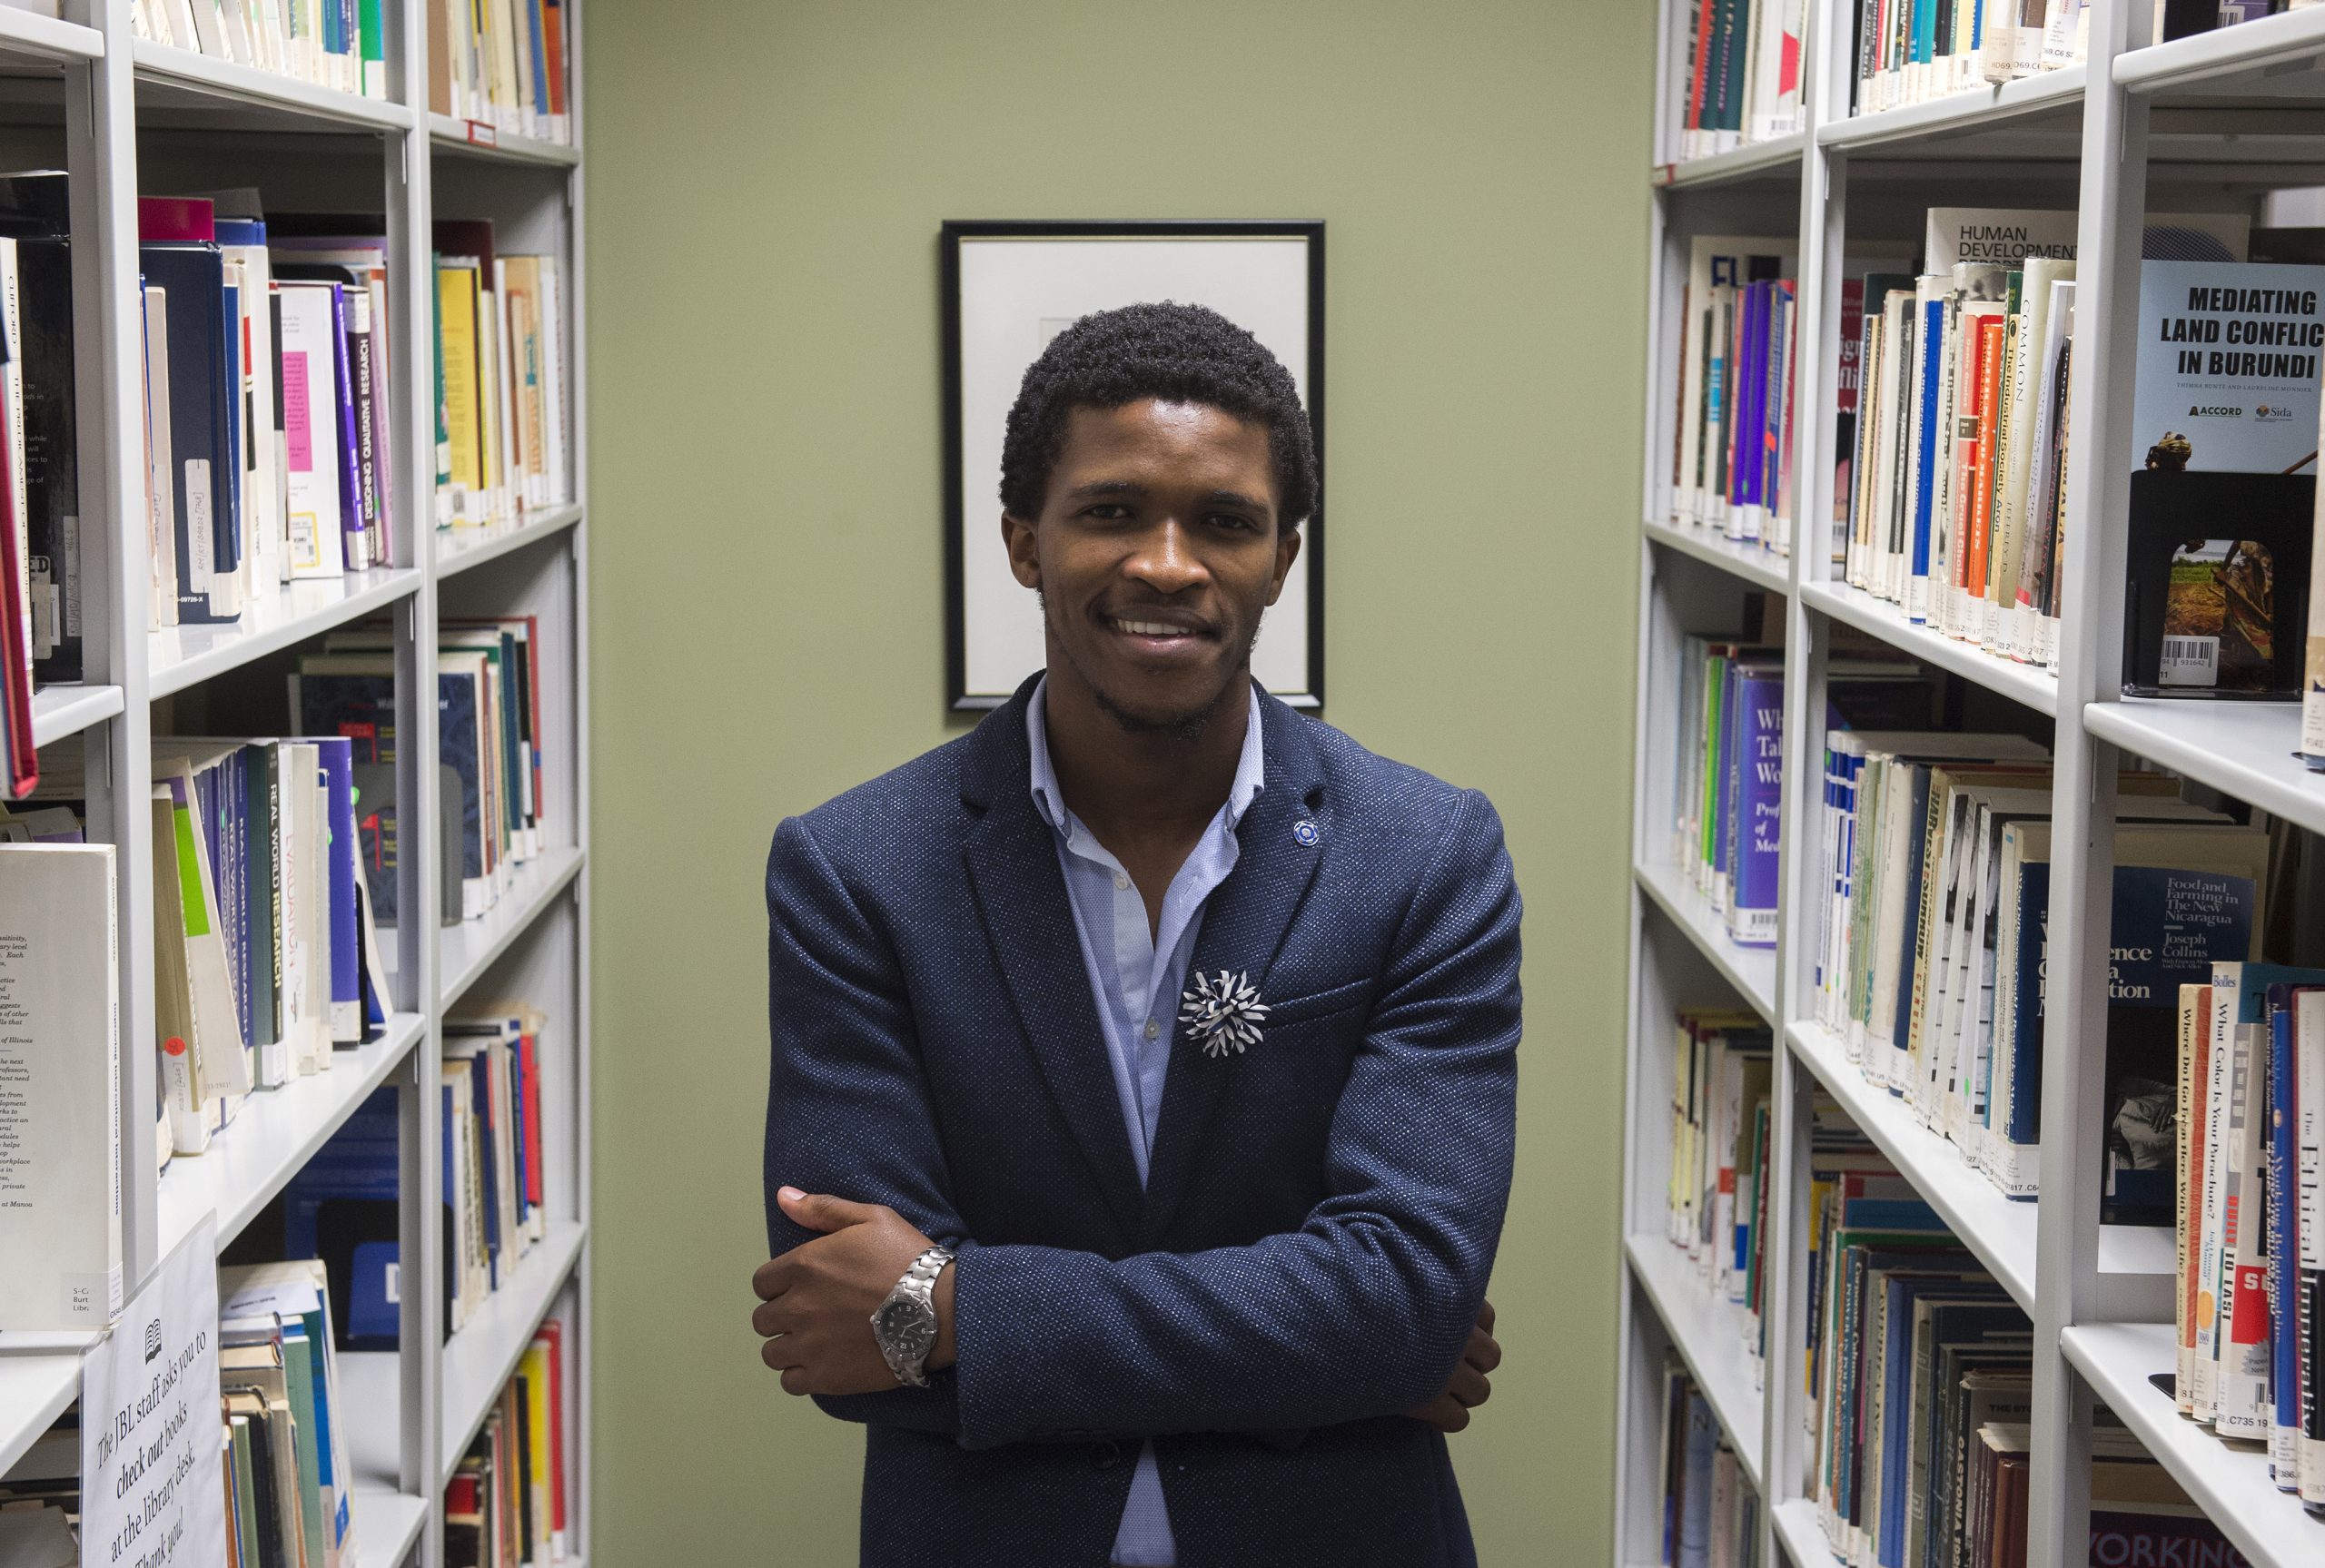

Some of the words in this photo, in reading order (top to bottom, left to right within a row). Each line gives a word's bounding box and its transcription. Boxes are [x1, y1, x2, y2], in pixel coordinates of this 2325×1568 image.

[1960, 225, 2027, 242] HUMAN
[8, 275, 17, 345] CLIFFORD
[2188, 286, 2317, 315] MEDIATING
[2160, 318, 2221, 343] LAND
[2226, 320, 2325, 348] CONFLIC
[360, 339, 370, 395] RESEARCH
[2005, 347, 2013, 372] The
[2013, 299, 2031, 402] COMMON
[2177, 350, 2202, 374] IN
[2208, 350, 2316, 379] BURUNDI
[1984, 331, 1994, 417] POLITICS
[2002, 373, 2013, 441] Industrial
[2200, 406, 2242, 417] ACCORD
[2270, 407, 2292, 418] Sida
[361, 399, 371, 459] QUALITATIVE
[1980, 421, 1988, 459] AND
[15, 408, 25, 506] PREDICAMENT
[1998, 443, 2008, 495] Society
[363, 460, 373, 519] DESIGNING
[1958, 493, 1967, 535] Cruel
[1974, 463, 1985, 550] MARKETS
[1994, 499, 2003, 533] Aron
[1756, 763, 1781, 784] Wo
[269, 783, 278, 826] REAL
[1754, 820, 1768, 838] of
[270, 828, 281, 889] WORLD
[285, 833, 296, 969] EVALUATION
[2166, 889, 2222, 904] Farming
[2225, 892, 2239, 904] in
[2167, 877, 2201, 890] Food
[2201, 881, 2227, 893] and
[2164, 910, 2231, 927] Nicaragua
[2165, 899, 2191, 911] The
[2193, 901, 2223, 913] New
[0, 935, 27, 943] sitivity,
[12, 942, 28, 951] level
[272, 892, 282, 988] RESEARCH
[2162, 945, 2208, 958] Collins
[2164, 932, 2207, 946] Joseph
[241, 941, 249, 1033] RESEARCH
[2212, 974, 2236, 989] Bolles
[2182, 1008, 2192, 1051] Where
[2217, 1002, 2228, 1042] What
[1, 1036, 8, 1045] of
[8, 1036, 33, 1044] Illinois
[0, 1066, 29, 1074] rofessors,
[2182, 1056, 2191, 1075] Do
[2214, 1046, 2225, 1088] Color
[0, 1100, 26, 1108] lopment
[7, 1091, 24, 1100] from
[2182, 1087, 2190, 1103] Go
[2213, 1091, 2222, 1103] Is
[2211, 1106, 2221, 1139] Your
[2304, 1109, 2314, 1135] The
[3, 1141, 20, 1149] helps
[2180, 1143, 2190, 1178] Here
[2, 1183, 25, 1191] private
[2207, 1142, 2220, 1219] Parachute?
[2179, 1181, 2187, 1215] With
[2300, 1143, 2320, 1264] Ethical
[2178, 1218, 2186, 1239] My
[2177, 1243, 2185, 1278] Life?
[2222, 1279, 2233, 1322] LAST
[97, 1432, 114, 1470] The
[114, 1405, 135, 1456] JBL
[136, 1374, 161, 1424] staff
[162, 1361, 178, 1397] asks
[178, 1348, 194, 1384] you
[196, 1330, 207, 1360] to
[1989, 1404, 2012, 1413] THE
[2227, 1415, 2254, 1427] .C735
[116, 1444, 145, 1500] check
[147, 1435, 164, 1469] out
[164, 1401, 188, 1450] books
[1954, 1435, 1964, 1531] GASTONIA
[111, 1540, 123, 1563] at
[124, 1511, 143, 1553] the
[143, 1472, 175, 1532] library
[174, 1440, 196, 1486] desk.
[134, 1533, 167, 1568] Thank
[167, 1506, 184, 1565] you!
